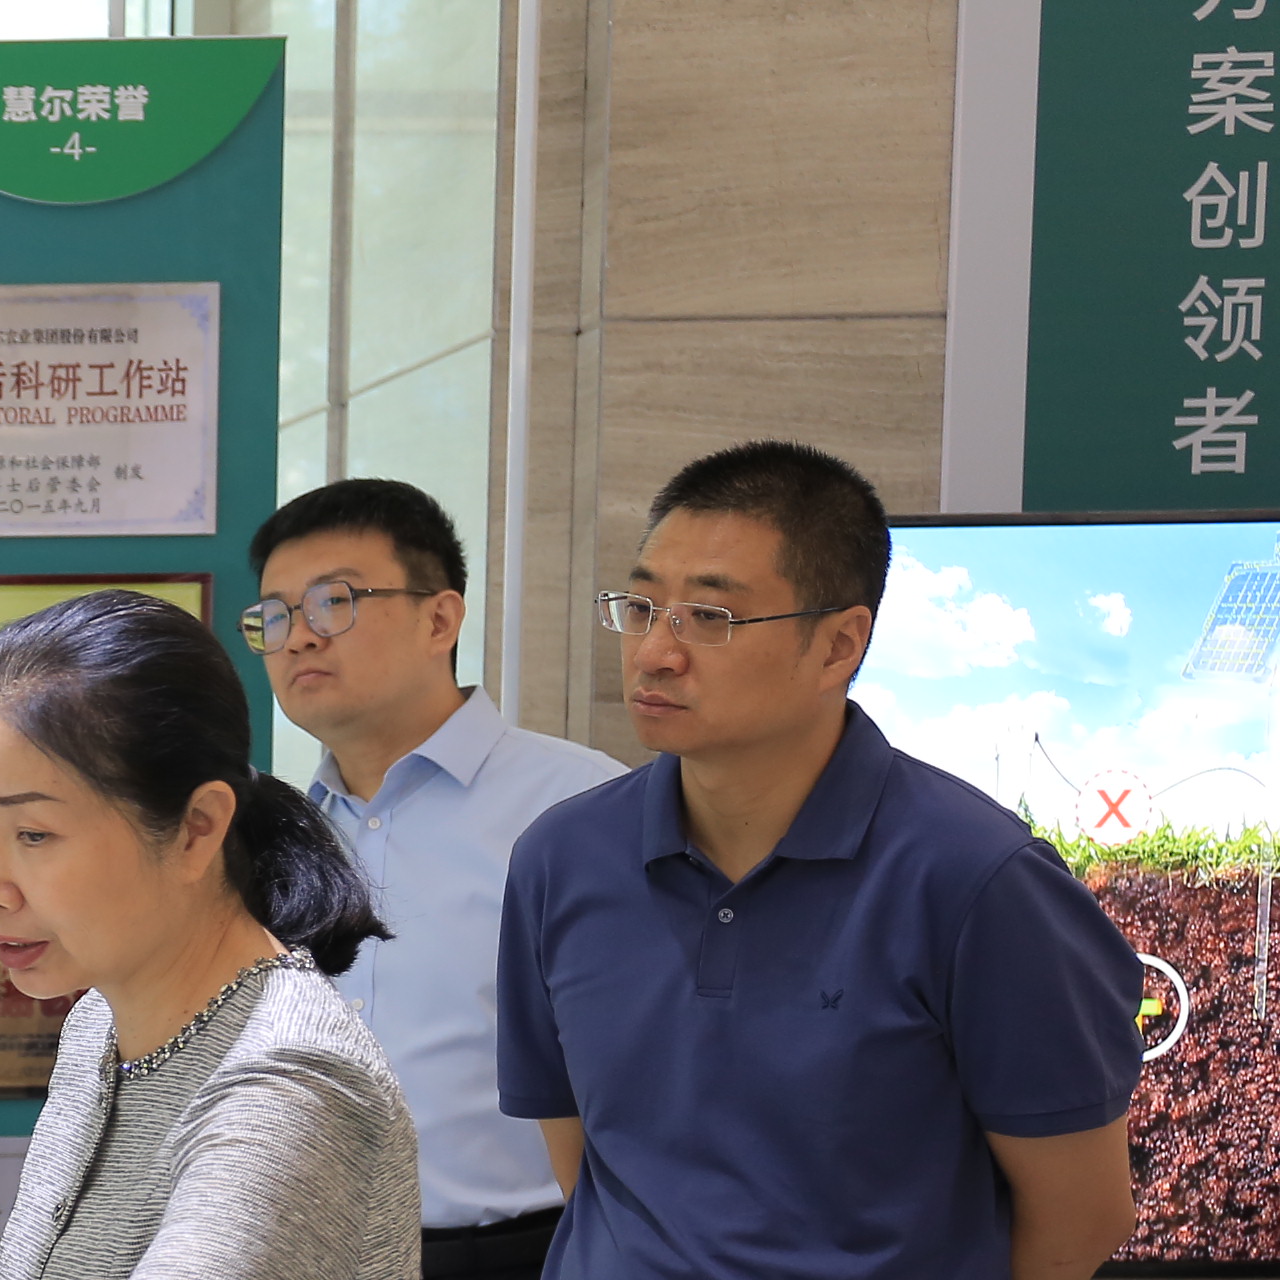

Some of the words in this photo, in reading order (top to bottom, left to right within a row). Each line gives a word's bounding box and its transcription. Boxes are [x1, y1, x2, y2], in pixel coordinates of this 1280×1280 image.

[1, 84, 149, 122] 慧尔荣誉
[49, 132, 97, 161] -4-
[1172, 0, 1275, 475] 案创领者
[66, 404, 188, 425] PROGRAMME
